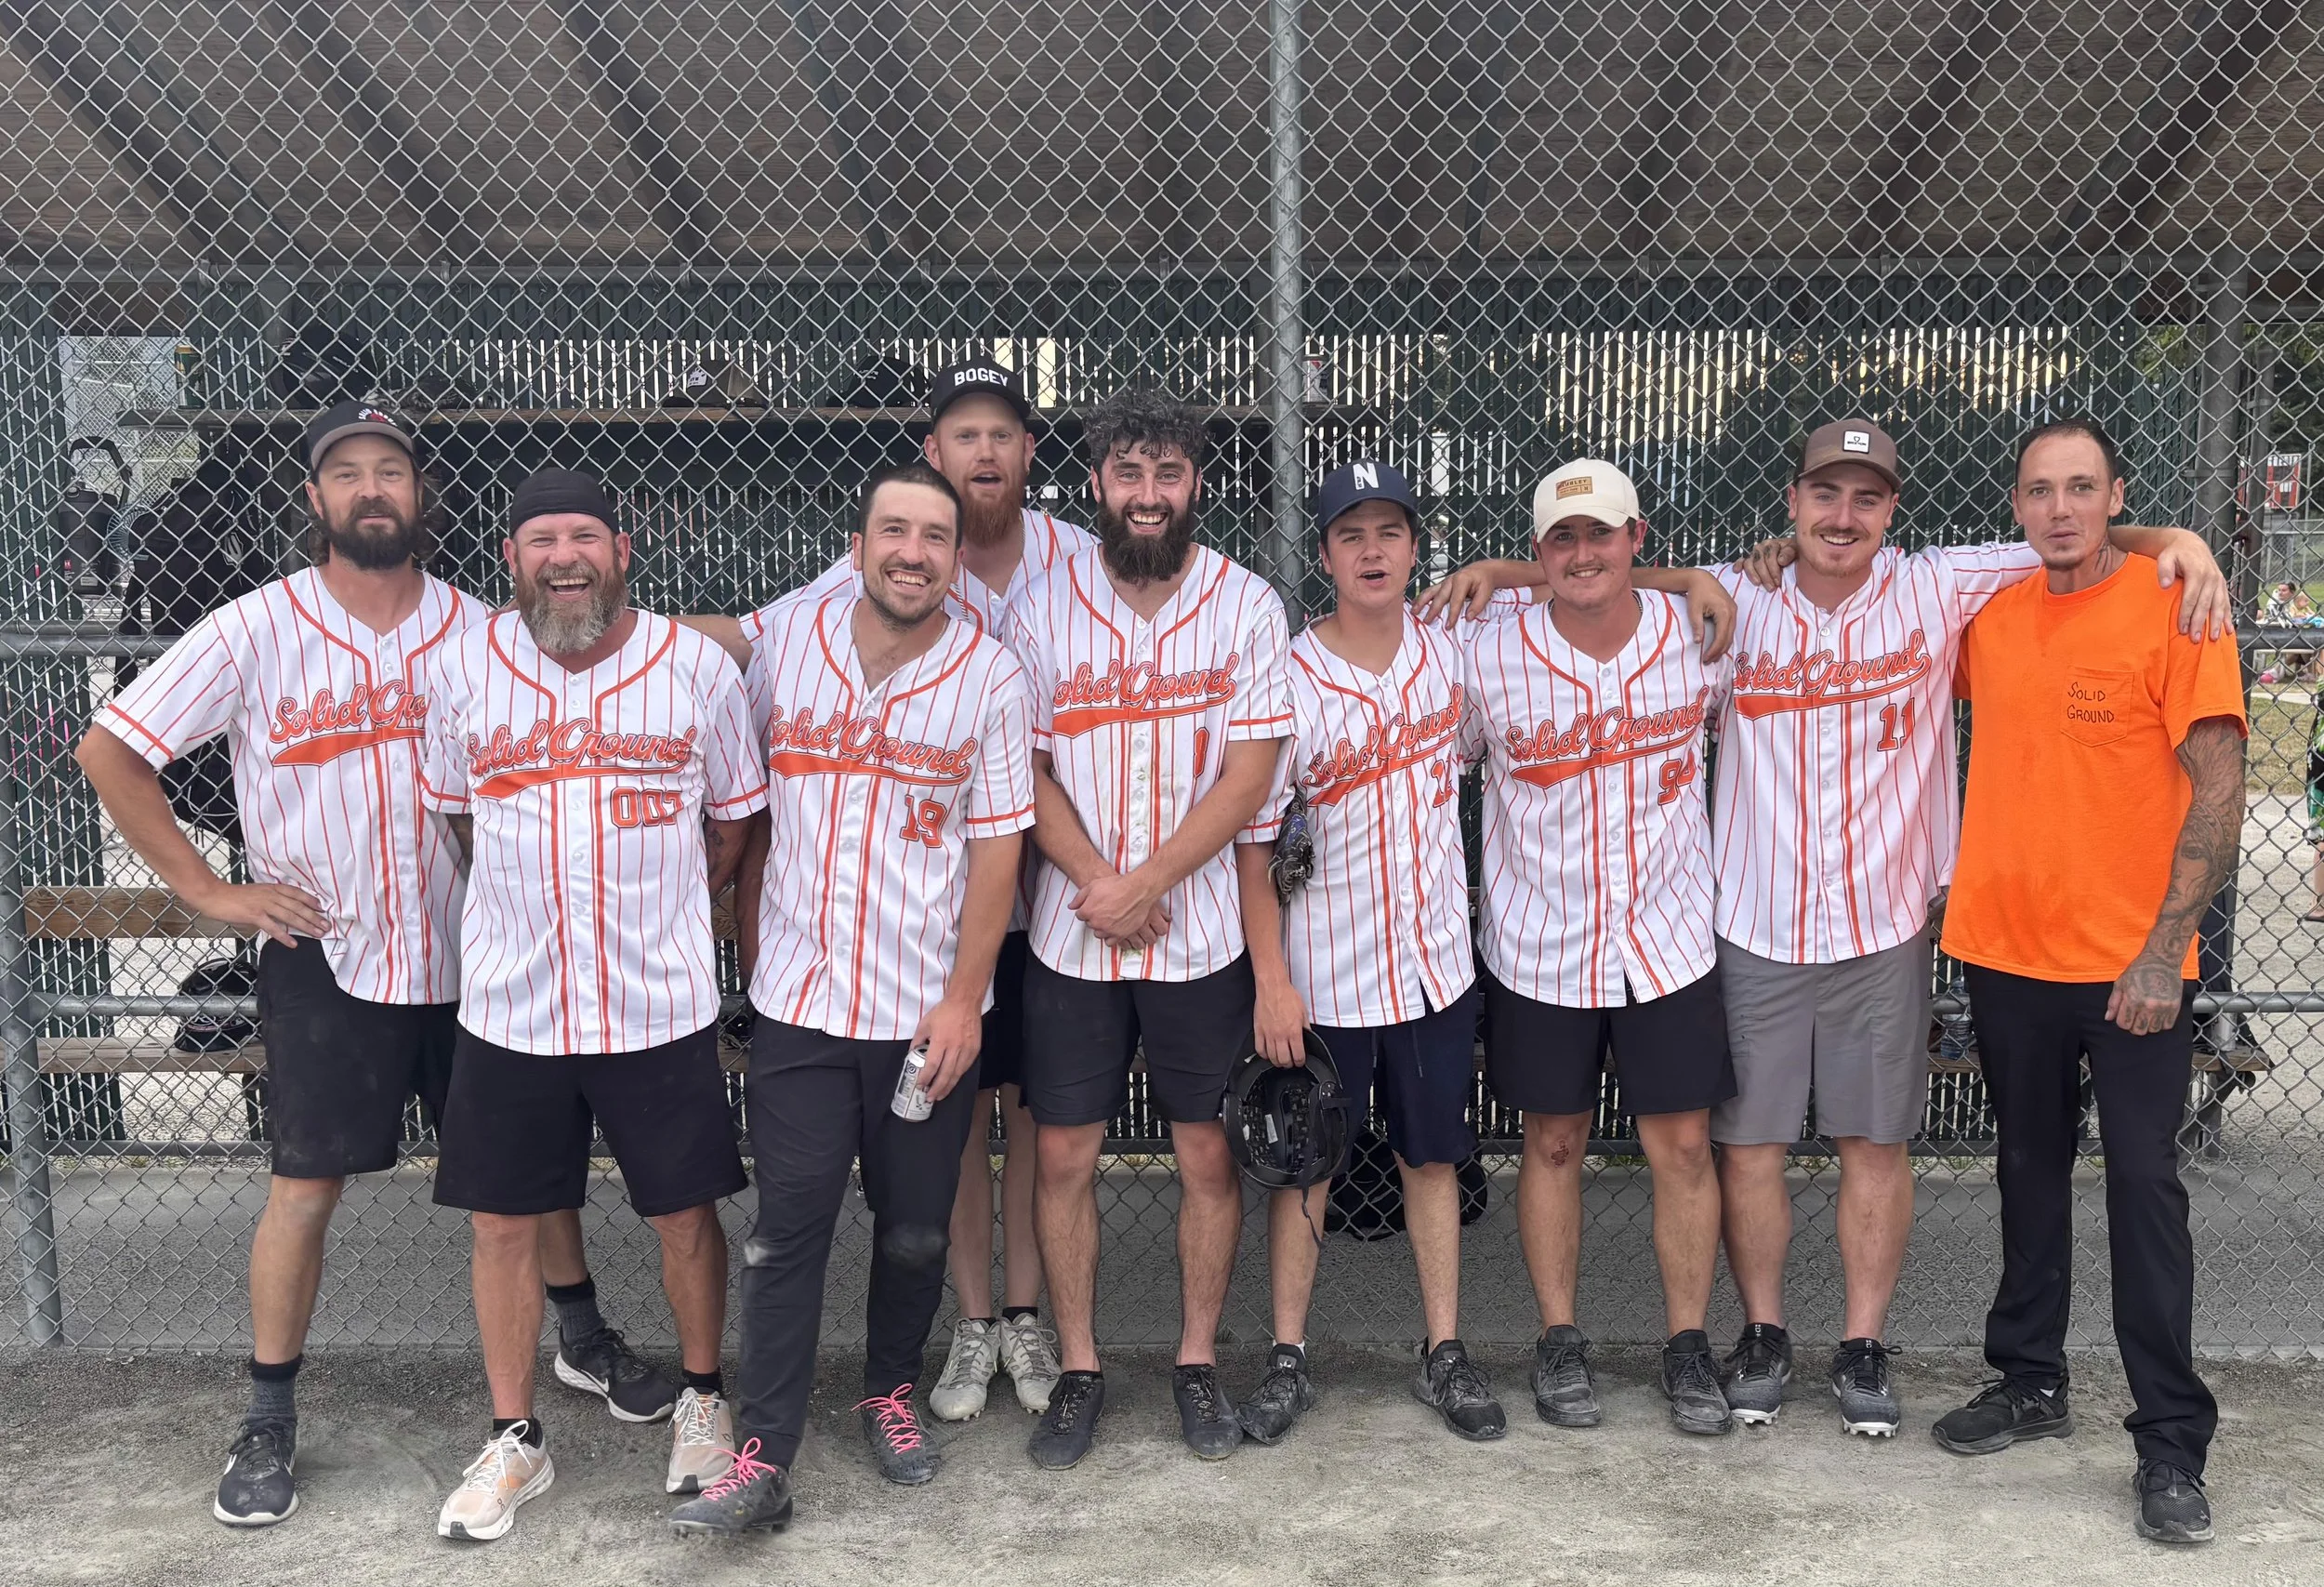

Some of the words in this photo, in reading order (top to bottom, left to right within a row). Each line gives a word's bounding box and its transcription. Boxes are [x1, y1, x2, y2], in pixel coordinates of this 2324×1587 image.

[954, 367, 1009, 387] BOGEY
[1353, 462, 1380, 490] N
[1117, 653, 1240, 705] Ground
[1801, 628, 1933, 694] Ground
[269, 683, 367, 744] Solid
[2067, 681, 2106, 702] SOLID
[2067, 704, 2115, 723] GROUND
[467, 719, 550, 777] Solid
[547, 718, 698, 764] Ground
[838, 716, 978, 776] Ground
[1507, 713, 1589, 761] Solid
[1587, 684, 1710, 751] Ground
[1876, 696, 1916, 752] 11
[1301, 725, 1381, 788] Solid
[899, 794, 948, 848] 19
